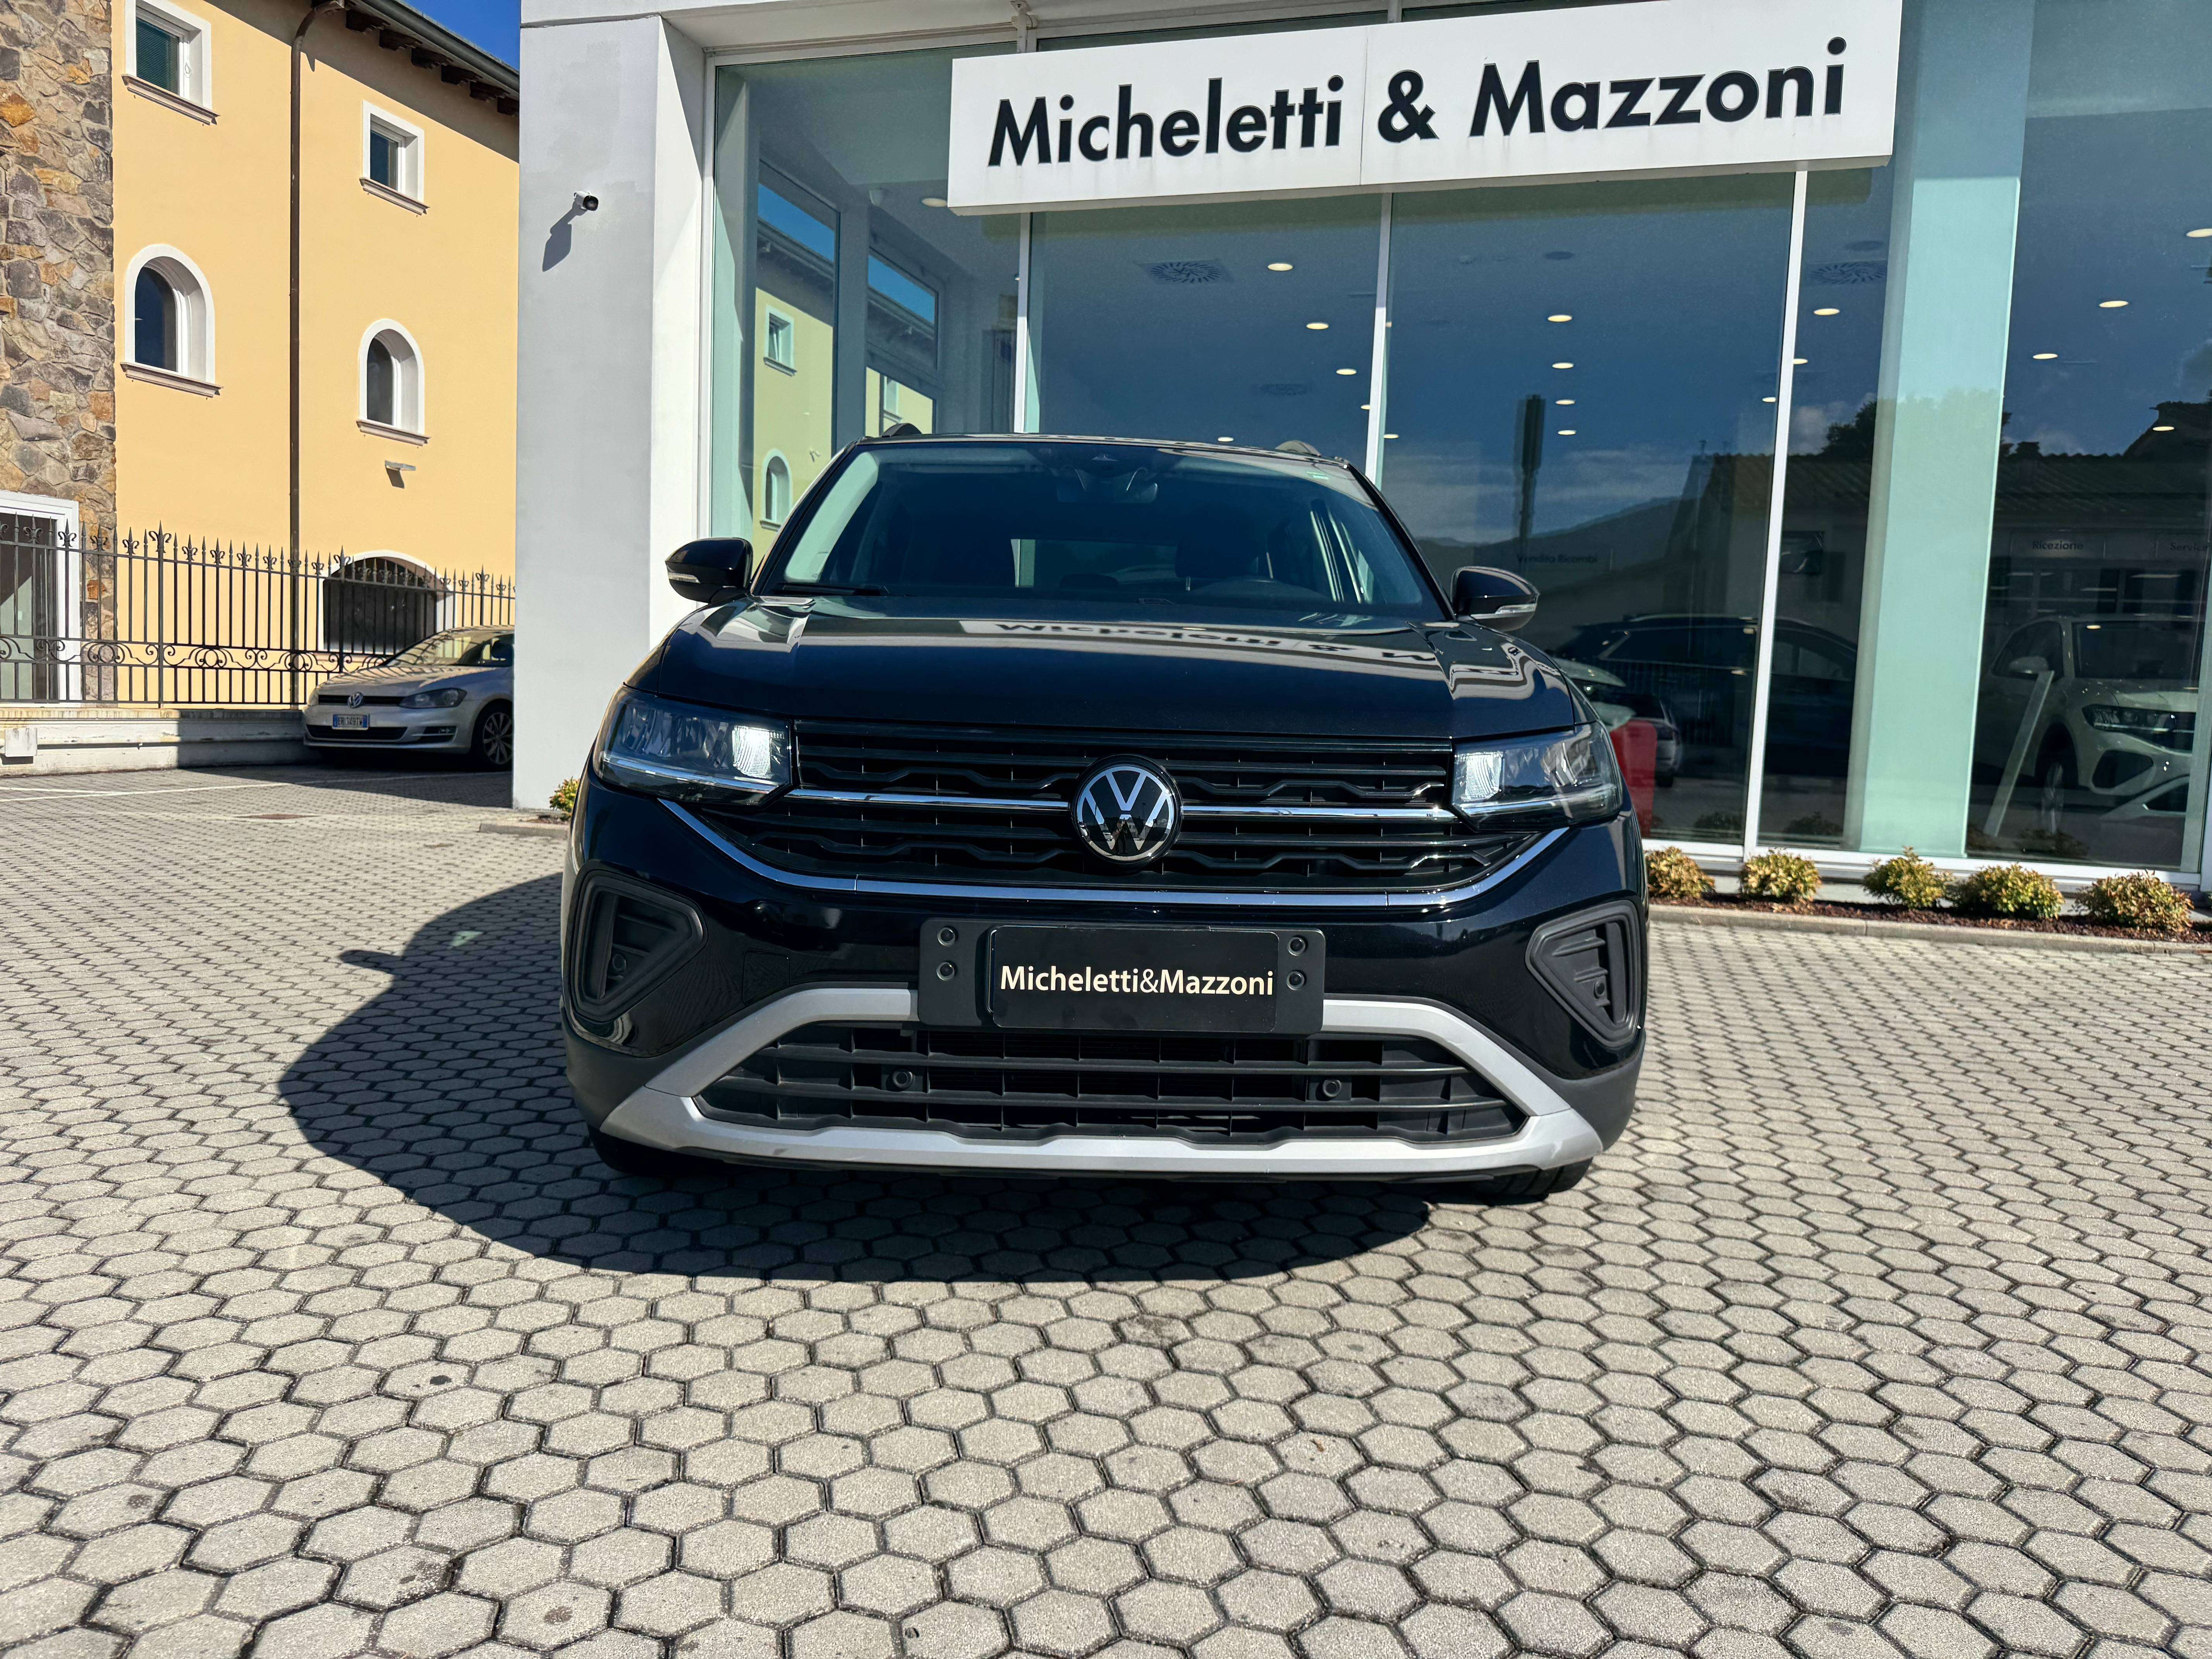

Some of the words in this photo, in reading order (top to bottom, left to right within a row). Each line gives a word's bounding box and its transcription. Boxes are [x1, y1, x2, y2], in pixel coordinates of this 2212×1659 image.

[988, 75, 1344, 166] Micheletti
[1378, 70, 1439, 143] &
[1470, 36, 1847, 137] Mazzoni
[2032, 540, 2083, 550] Ricezione
[1077, 766, 1175, 861] VW
[1000, 965, 1273, 995] Micheletti&Mazzoni
